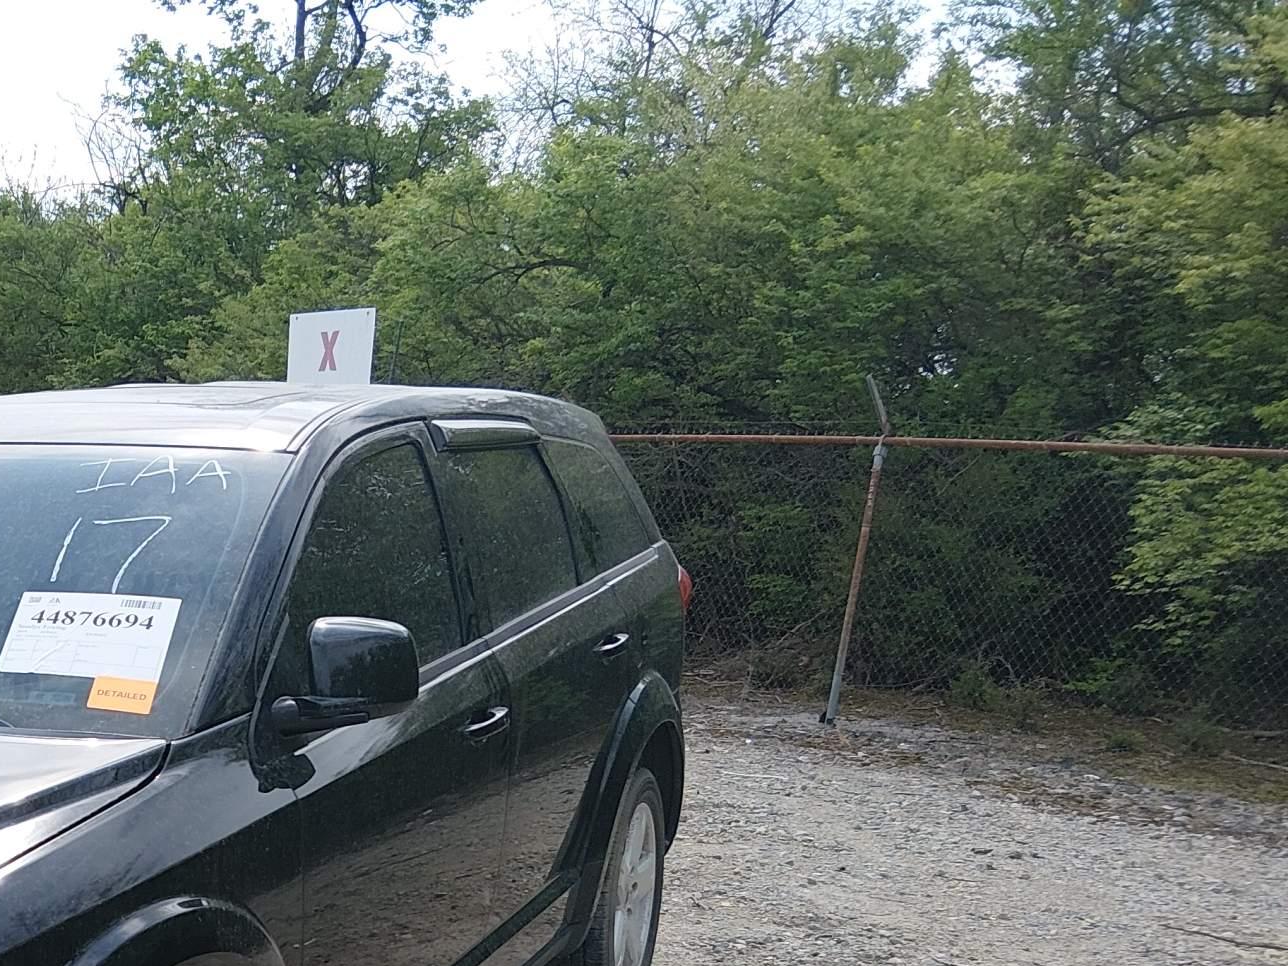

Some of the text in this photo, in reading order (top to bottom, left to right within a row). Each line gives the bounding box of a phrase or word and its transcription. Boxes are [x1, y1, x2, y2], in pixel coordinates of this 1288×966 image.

[318, 330, 340, 372] X
[76, 455, 232, 494] IAA
[50, 516, 173, 594] 17
[30, 609, 155, 631] 44876694
[96, 688, 148, 702] DETAILED
